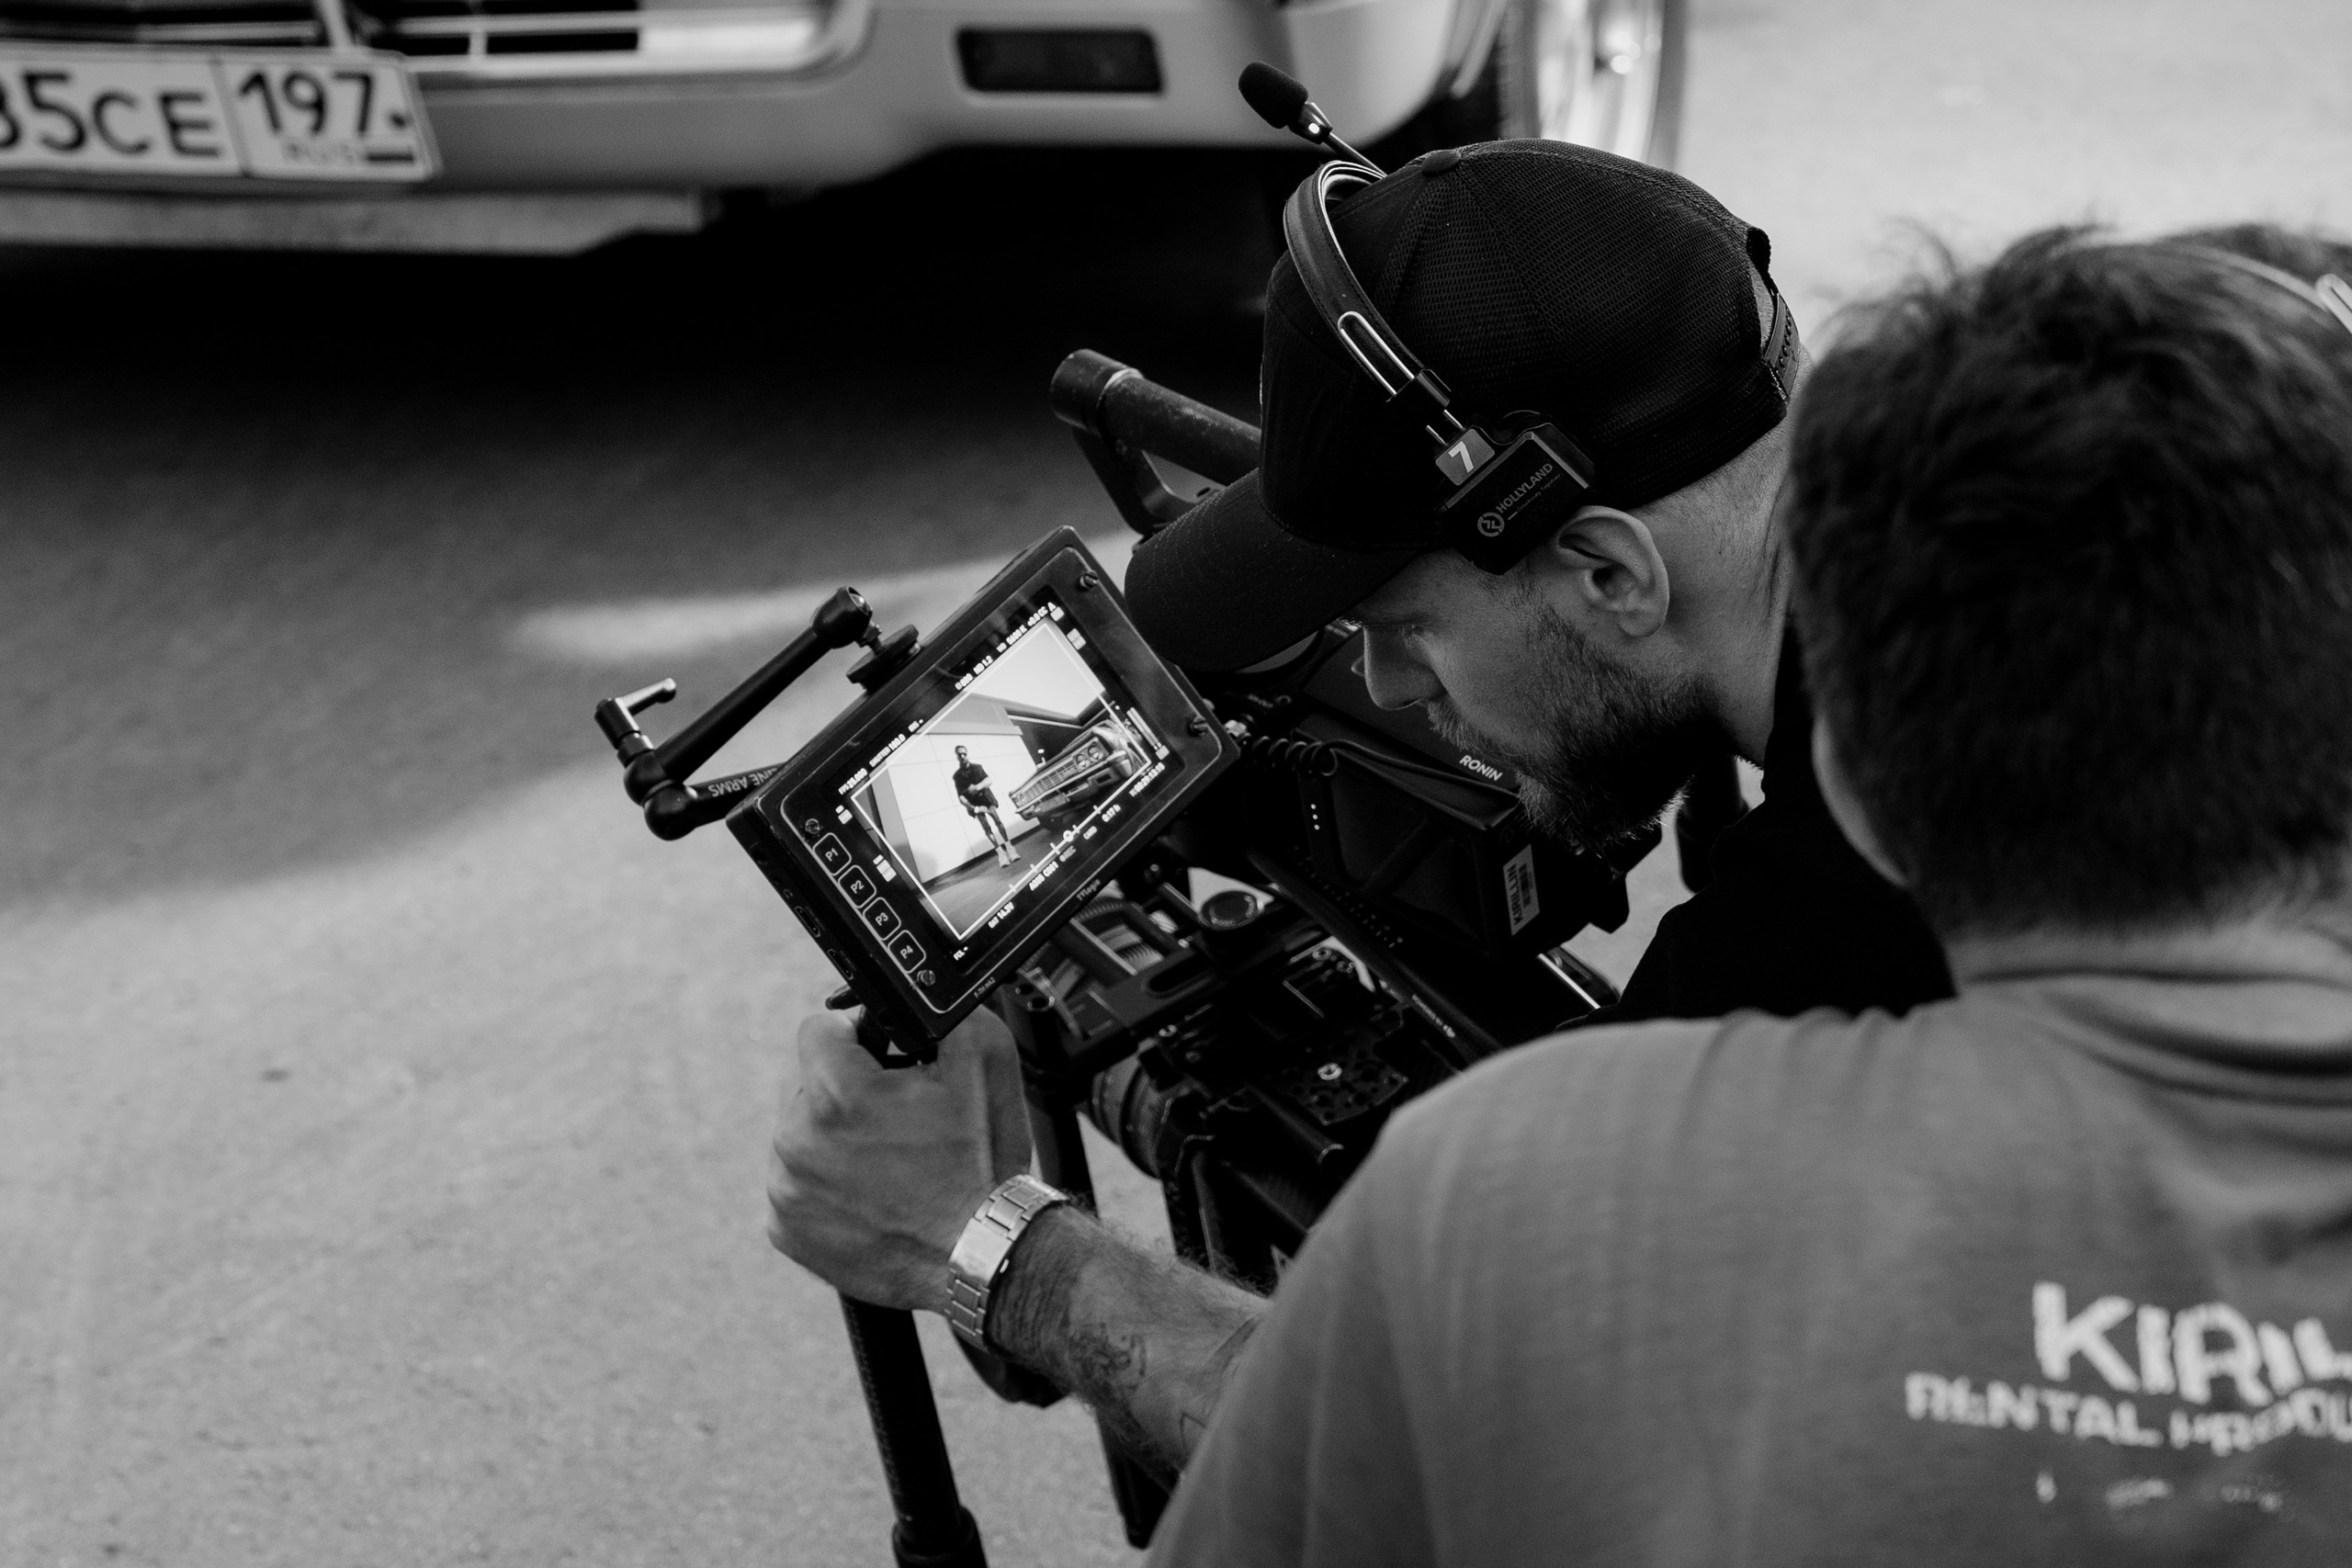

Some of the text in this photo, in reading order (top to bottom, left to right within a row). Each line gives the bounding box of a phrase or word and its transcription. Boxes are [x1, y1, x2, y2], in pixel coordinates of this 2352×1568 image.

[237, 69, 377, 136] 197
[1448, 441, 1474, 473] 7
[1496, 463, 1553, 513] HOLLYLAND
[1459, 754, 1503, 781] RONIN
[708, 777, 748, 797] ARMS
[825, 848, 838, 862] P1
[850, 880, 865, 894] P2
[875, 912, 888, 926] P3
[899, 945, 913, 959] P4
